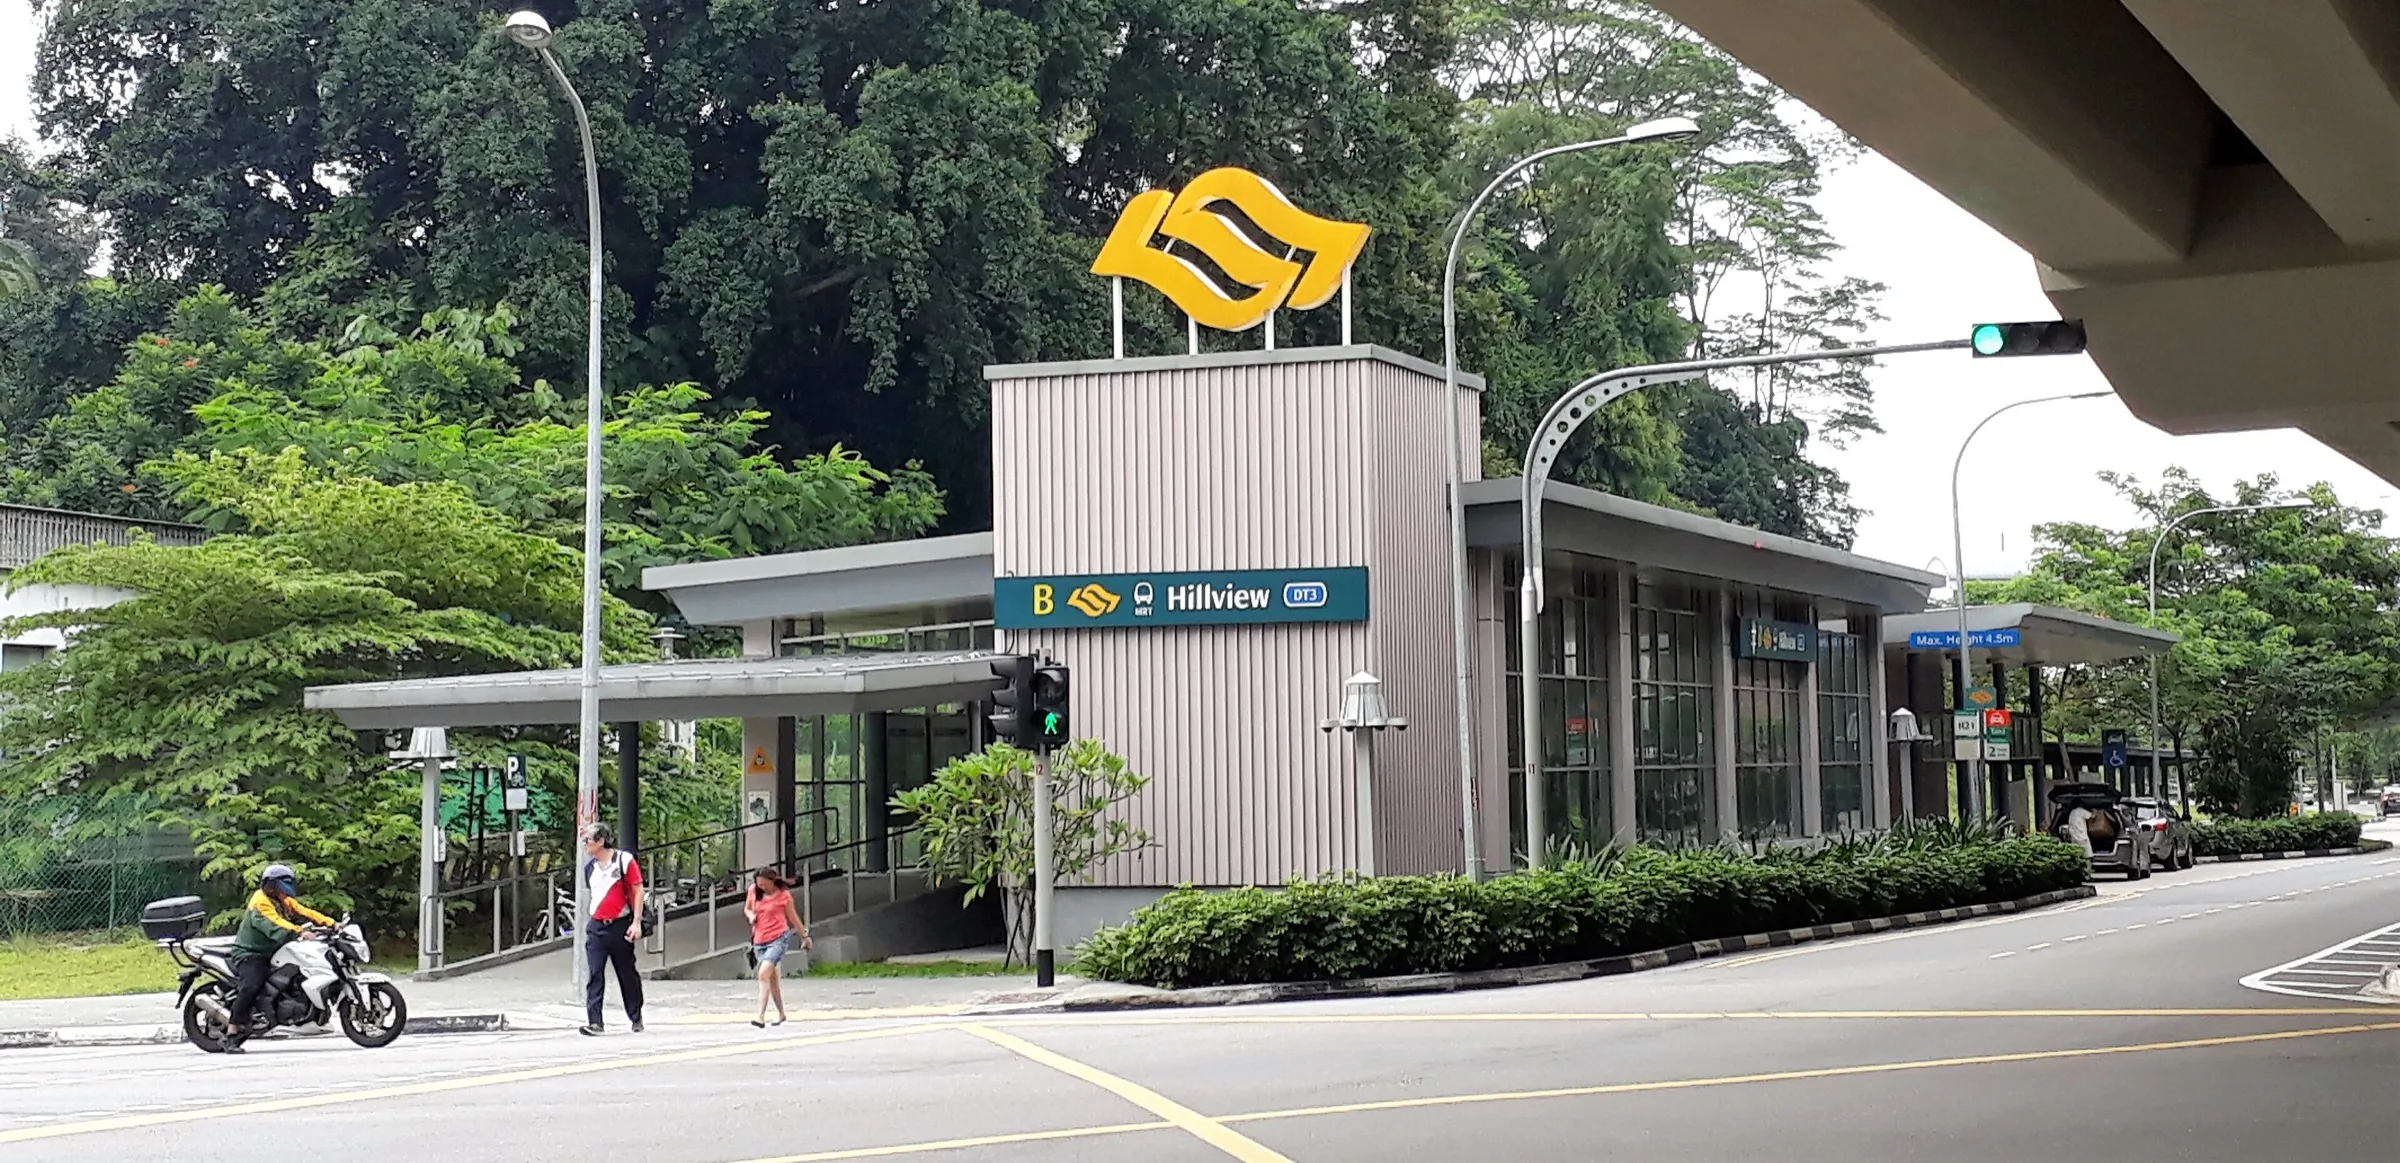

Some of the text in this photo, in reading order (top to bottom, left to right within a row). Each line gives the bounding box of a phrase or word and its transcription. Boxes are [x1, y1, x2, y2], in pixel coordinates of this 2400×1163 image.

[1033, 583, 1318, 615] B Hillview DT3
[1134, 606, 1154, 617] MRT
[1916, 633, 2014, 646] Max. Heght 4.5m
[1989, 746, 1996, 757] 2
[507, 756, 519, 781] P
